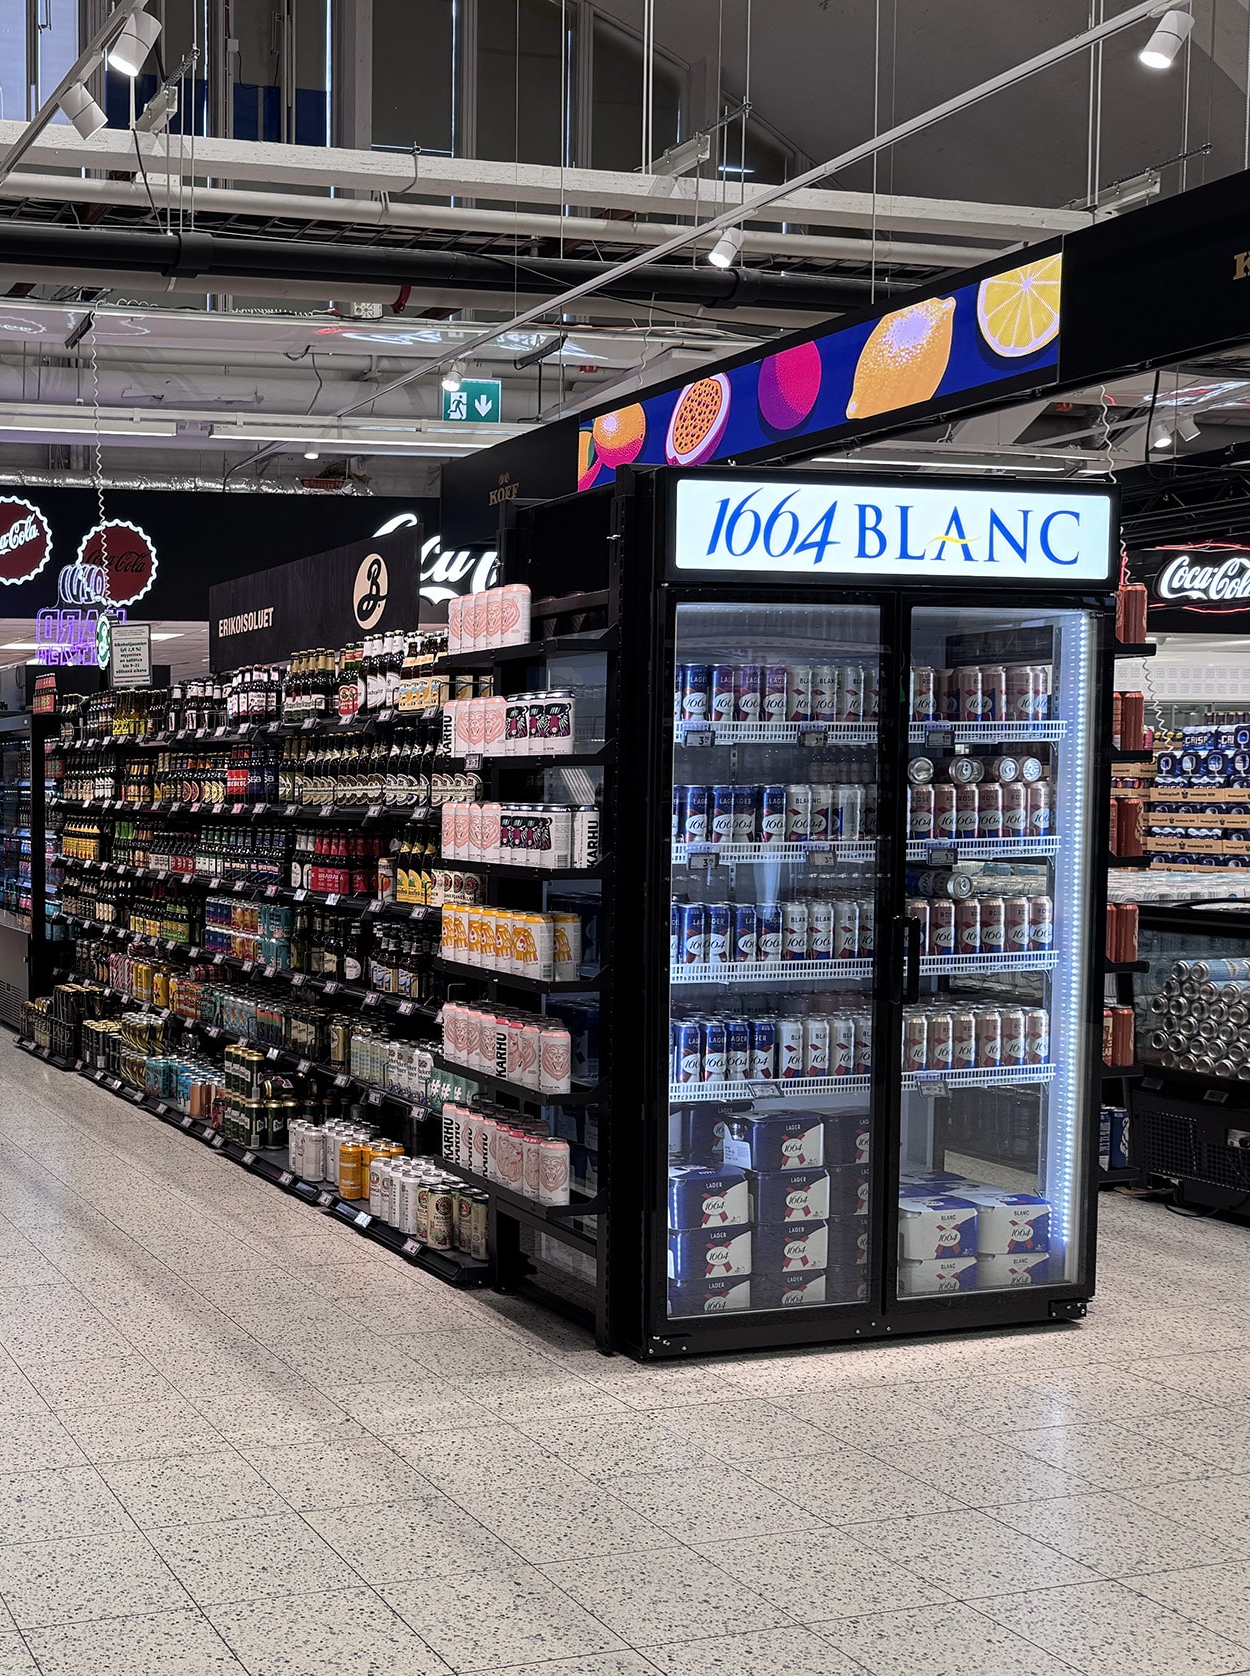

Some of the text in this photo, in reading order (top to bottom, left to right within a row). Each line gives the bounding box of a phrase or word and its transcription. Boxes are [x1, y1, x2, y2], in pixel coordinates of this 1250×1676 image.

[488, 483, 519, 506] KOFF
[706, 487, 1081, 565] 1664 BLANC
[218, 607, 274, 638] ERIKOISOLUET
[1221, 735, 1235, 745] CRI
[586, 820, 600, 869] KARHU
[496, 1032, 507, 1078] KARHU
[443, 1117, 454, 1161] KARHU
[784, 1143, 803, 1153] 1664
[705, 1181, 723, 1189] LAGER
[788, 1195, 808, 1205] 1664
[704, 1201, 726, 1211] 1664
[710, 1231, 727, 1239] LAGER
[938, 1233, 958, 1242] 1664
[1011, 1228, 1031, 1237] 1664
[786, 1245, 807, 1255] 1664
[708, 1251, 730, 1261] 1664
